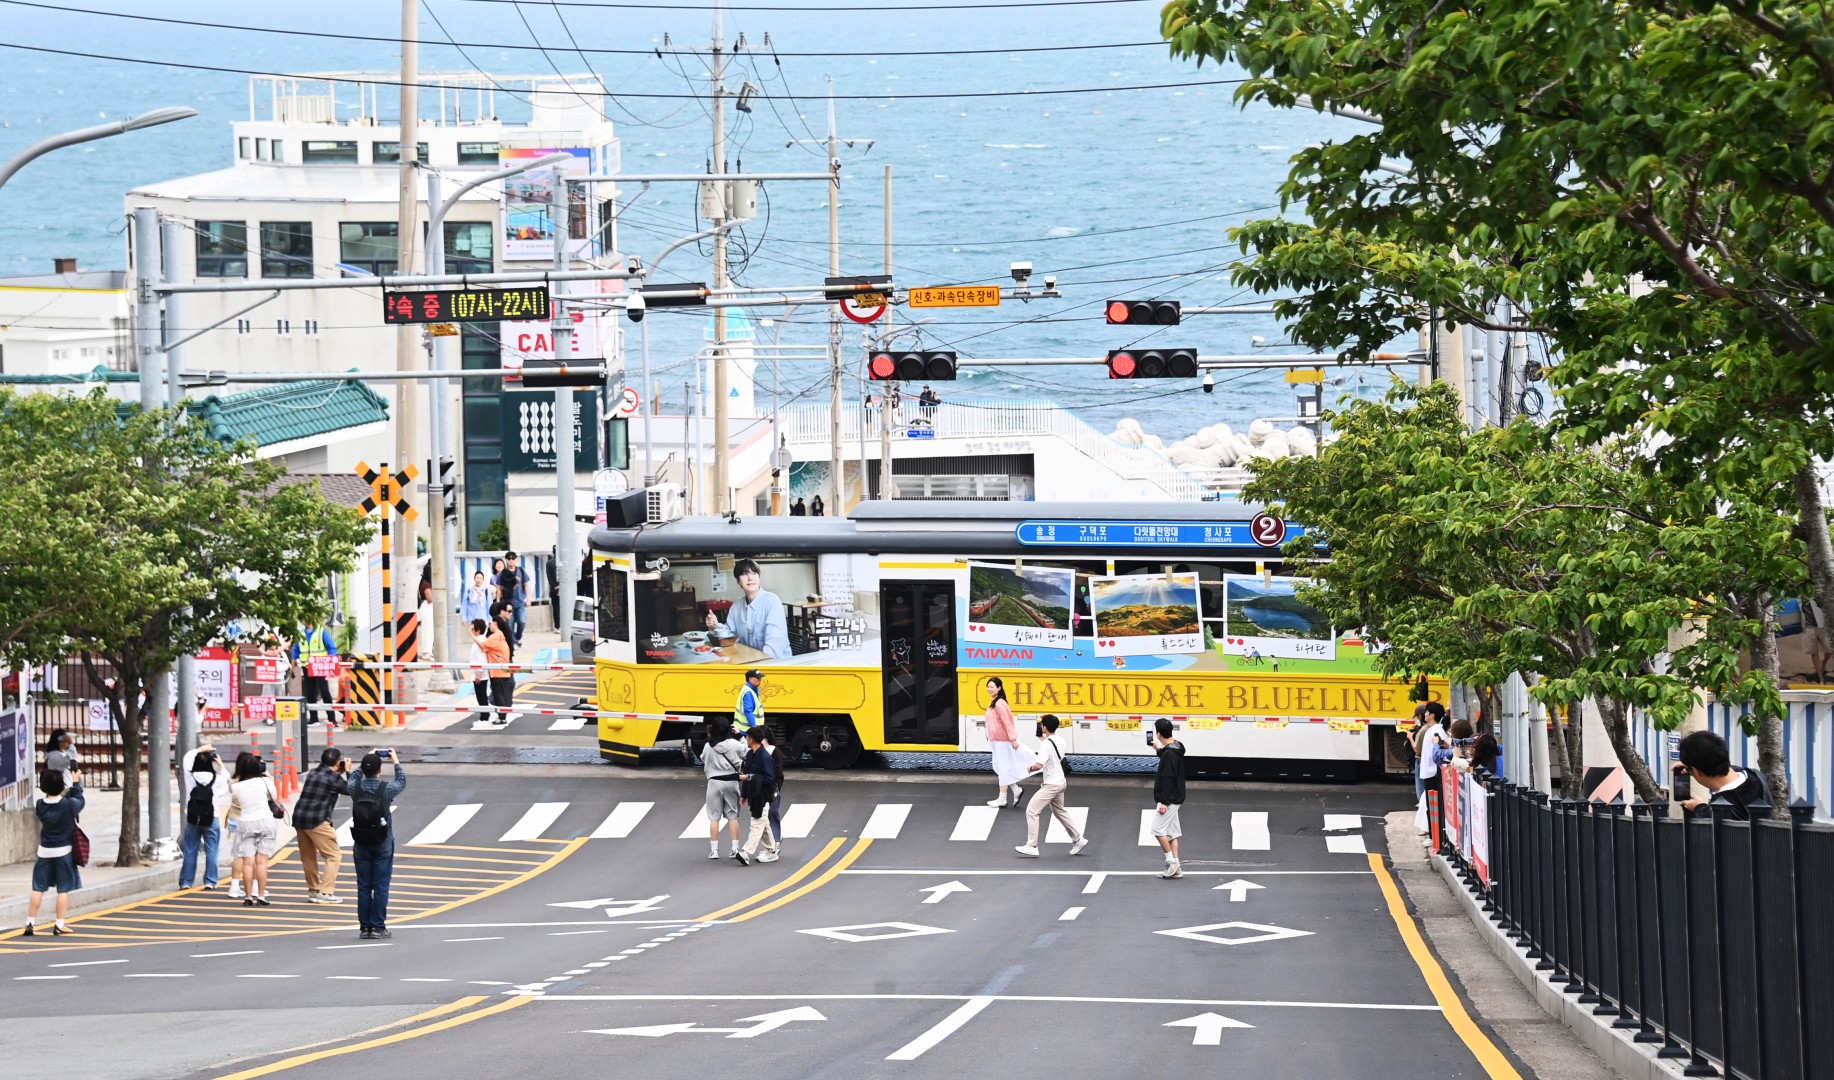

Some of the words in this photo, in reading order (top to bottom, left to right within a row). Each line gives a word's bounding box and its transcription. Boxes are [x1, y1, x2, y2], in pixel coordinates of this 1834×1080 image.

[423, 294, 440, 319] 중
[518, 334, 579, 352] CAE
[1259, 516, 1277, 541] 2
[964, 648, 1034, 660] TAIWAN
[1013, 683, 1206, 710] HAEUNDAE
[1227, 685, 1398, 712] BLUELINE
